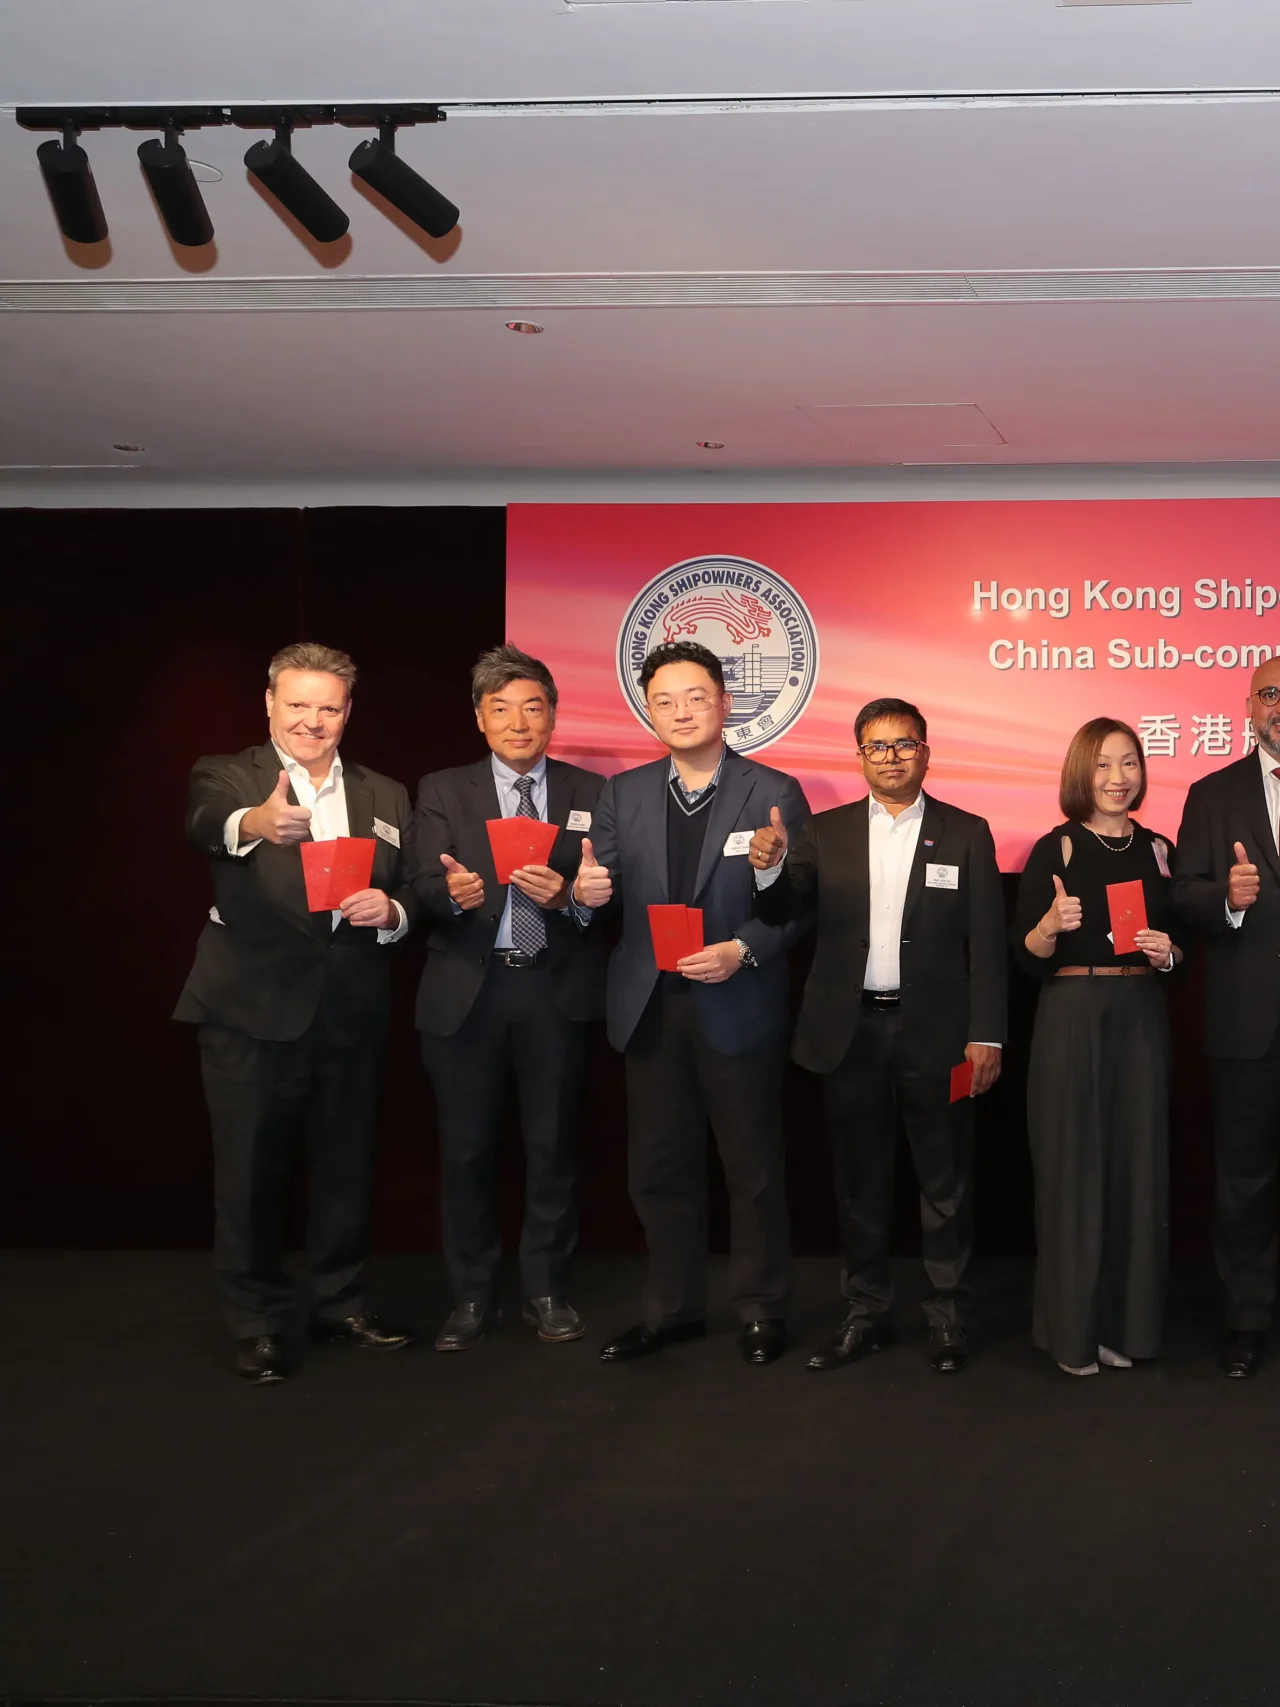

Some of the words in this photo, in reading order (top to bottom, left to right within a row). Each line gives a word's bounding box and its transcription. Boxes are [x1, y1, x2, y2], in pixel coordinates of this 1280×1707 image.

[669, 570, 763, 598] SHIPOWNERS
[973, 580, 1070, 618] Hong
[1083, 579, 1181, 617] Kong
[638, 592, 669, 630] KONG
[760, 587, 805, 672] ASSOCIATION
[631, 631, 647, 671] HONG
[988, 639, 1095, 670] China
